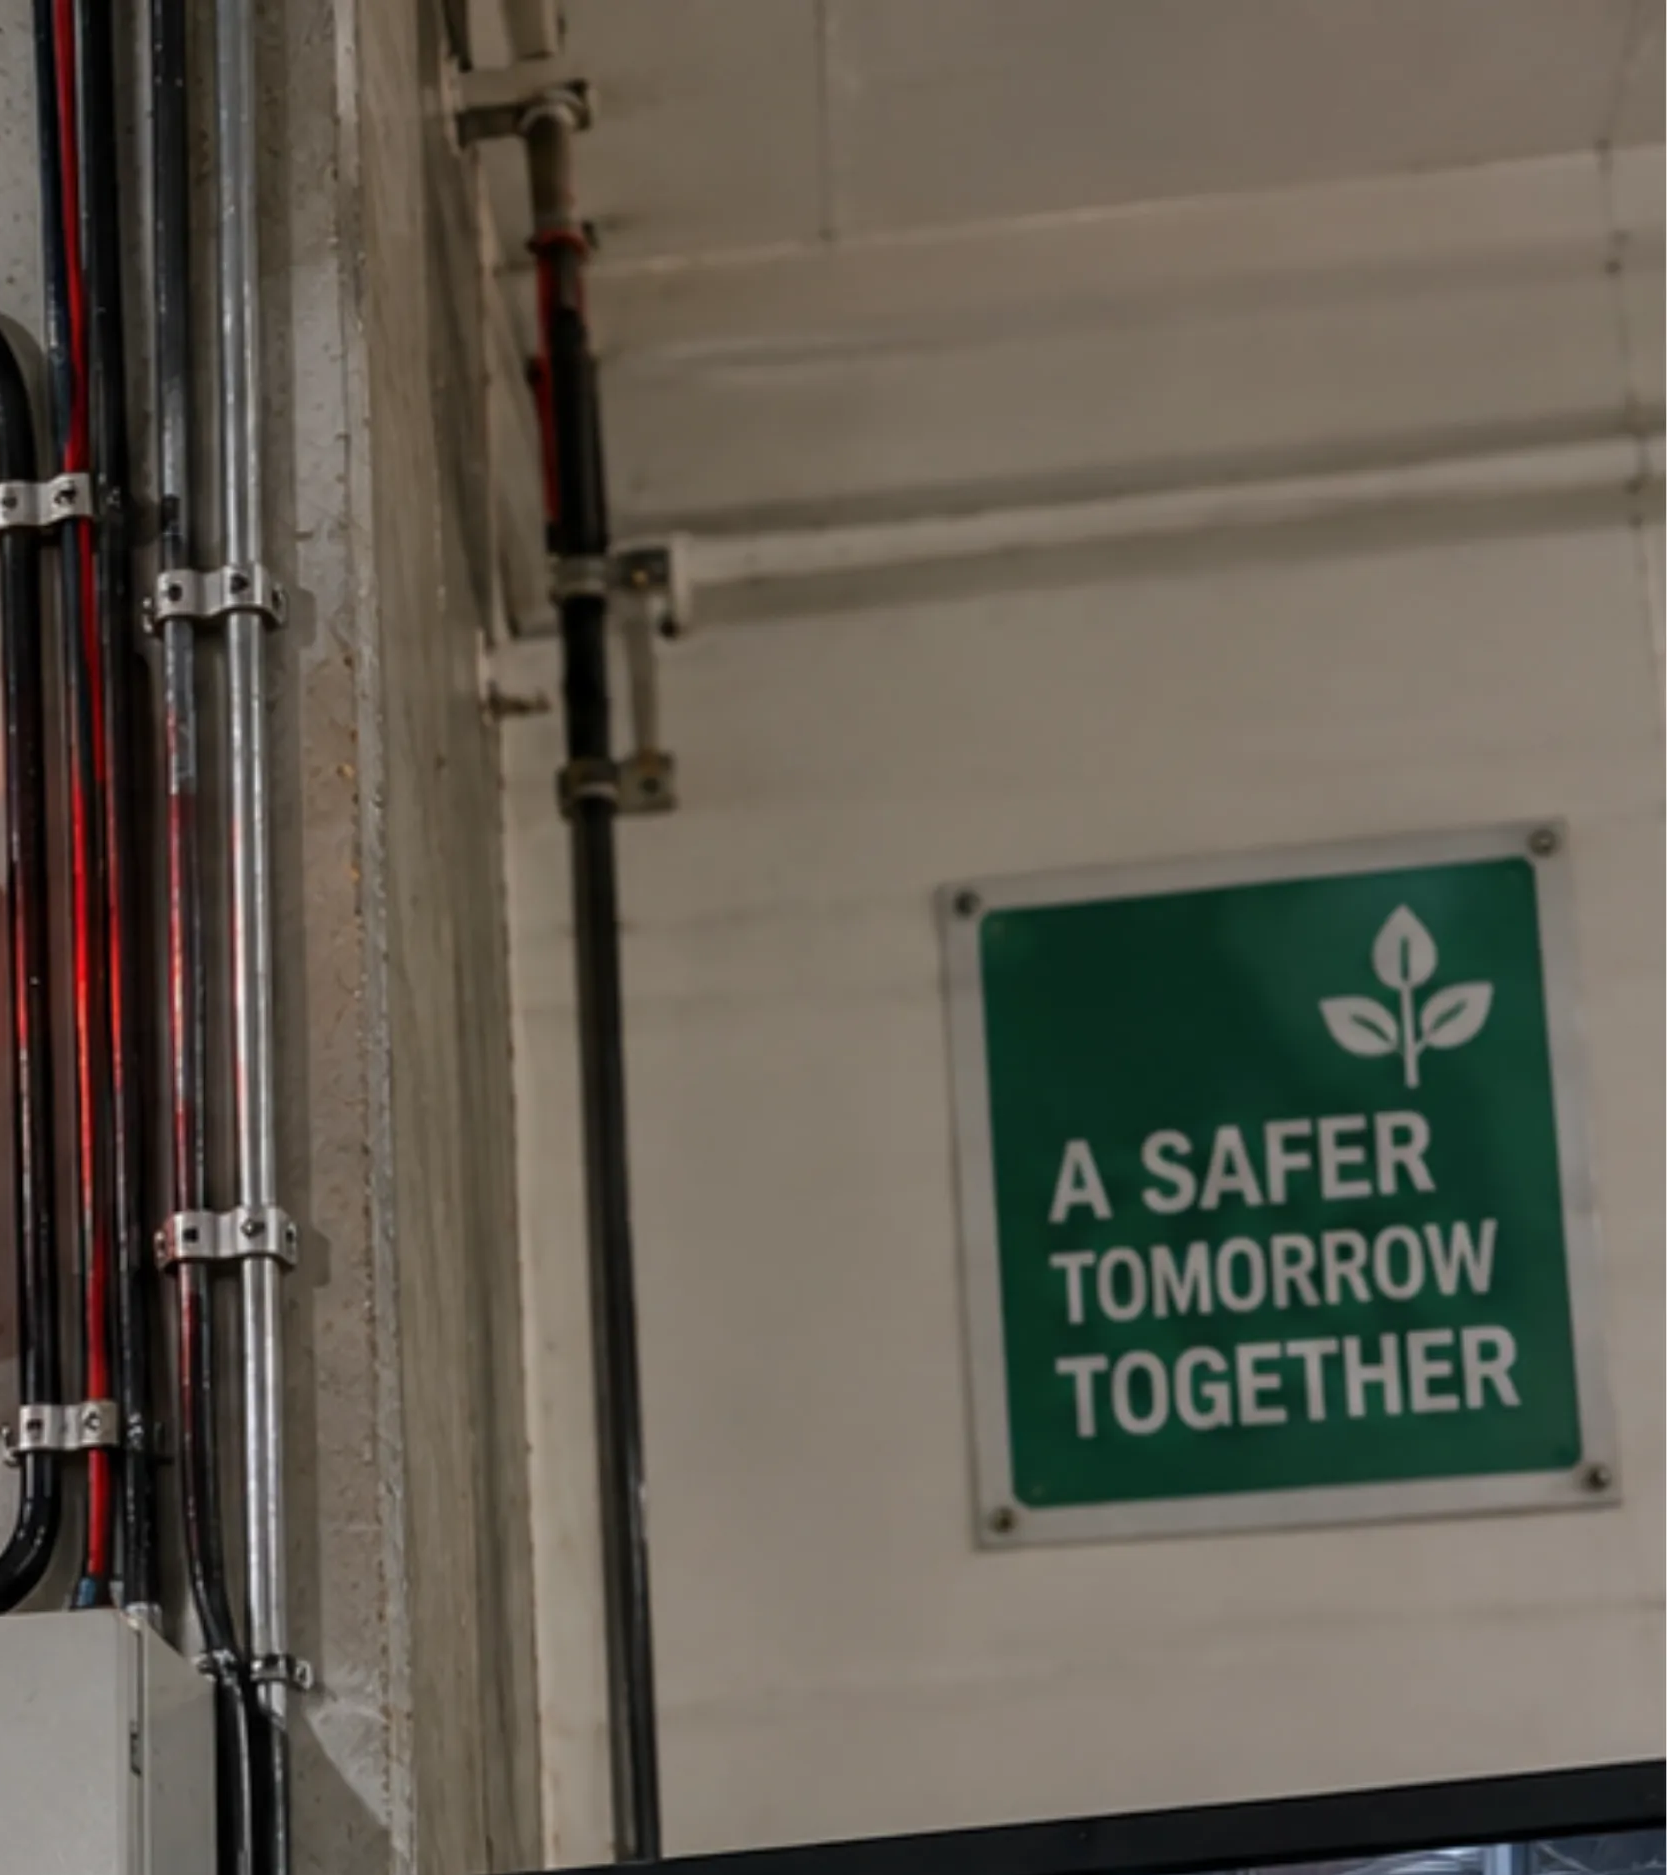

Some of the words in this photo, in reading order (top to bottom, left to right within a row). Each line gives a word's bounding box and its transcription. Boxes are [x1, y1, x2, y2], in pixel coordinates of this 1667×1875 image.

[1049, 1139, 1113, 1223] A
[1141, 1109, 1436, 1214] SAFER
[1049, 1218, 1498, 1324] TOMORROW
[1055, 1324, 1521, 1438] TOGETHER
